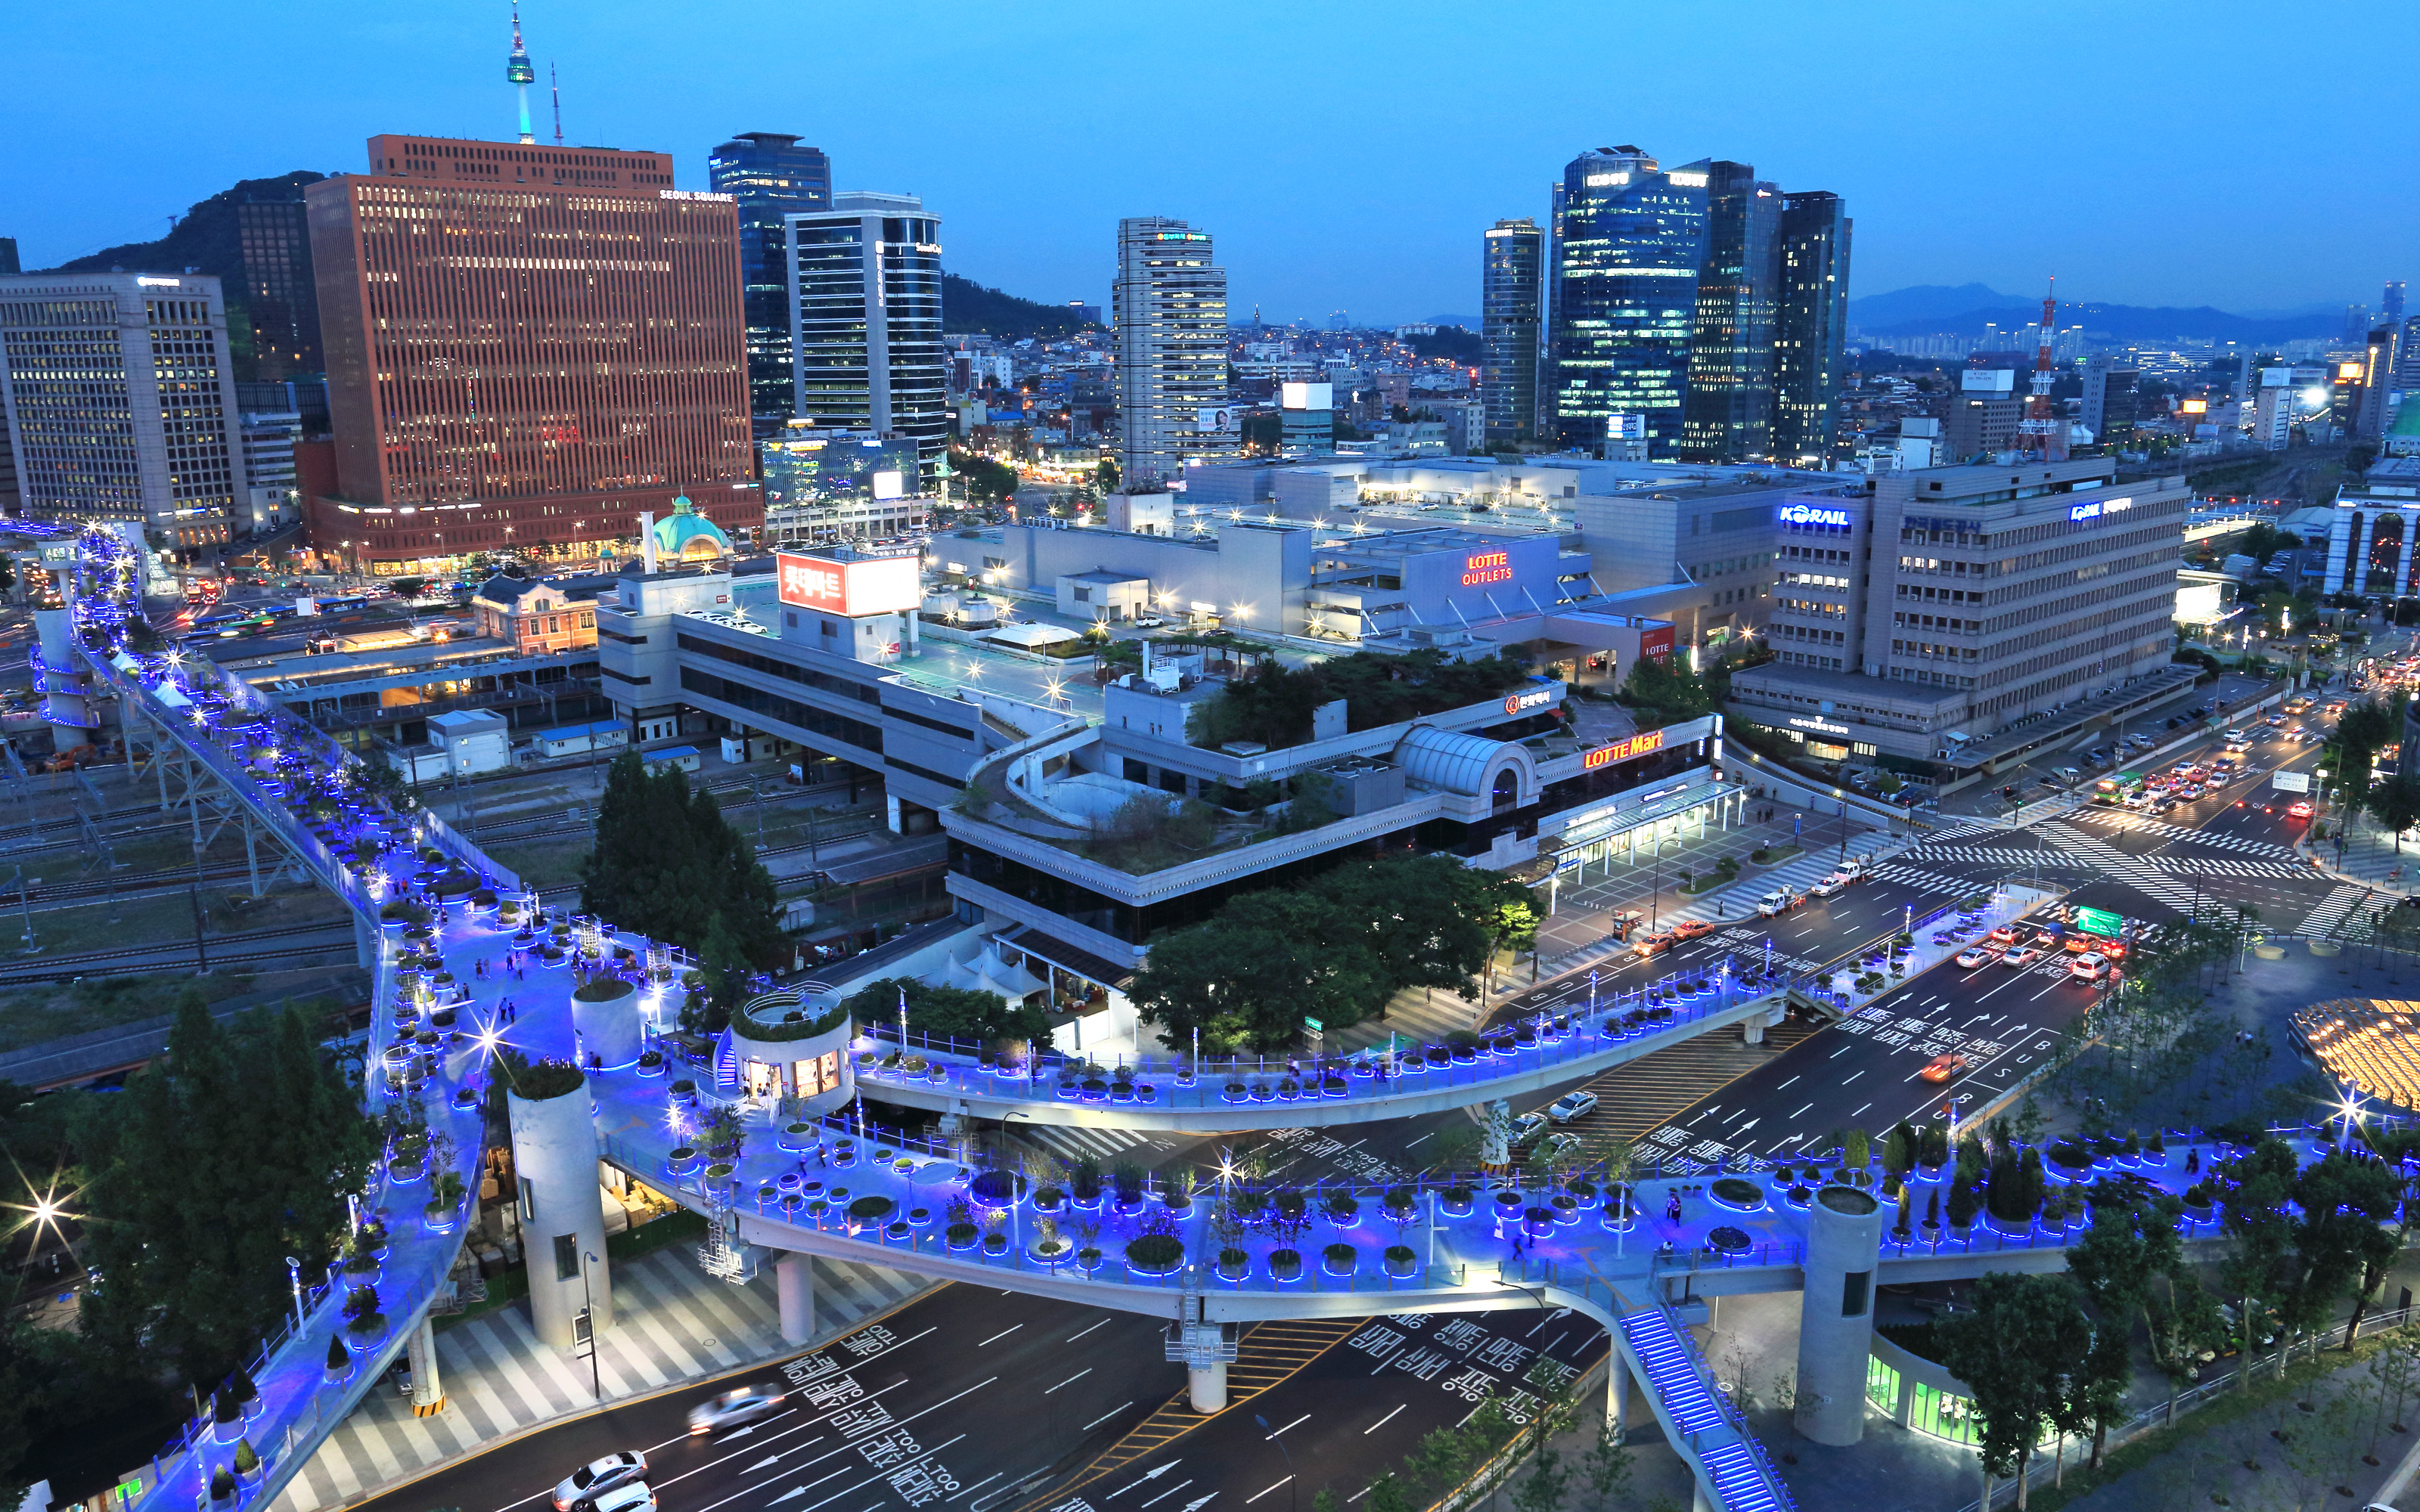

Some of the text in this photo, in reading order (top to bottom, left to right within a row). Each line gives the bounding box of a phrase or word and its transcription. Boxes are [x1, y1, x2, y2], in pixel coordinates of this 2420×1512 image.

[659, 189, 734, 203] SEOUL SQUARE
[915, 241, 932, 253] Seoul
[1779, 504, 1848, 525] KORAIL
[2071, 503, 2100, 522] KORAIL
[1468, 552, 1507, 570] LOTTE
[785, 565, 841, 600] 롯데마트
[1462, 567, 1512, 586] OUTLETS
[1584, 730, 1664, 770] LOTTE Mart
[1857, 1006, 1895, 1023] 청파동
[1894, 1017, 1933, 1033] 청파동
[1835, 1018, 1875, 1035] 삼거리
[1872, 1029, 1913, 1046] 삼거리
[1928, 1027, 1969, 1045] 만리동
[1909, 1039, 1950, 1058] 공덕동
[1965, 1038, 2007, 1055] 만리동
[1300, 1136, 1346, 1158] 서소문
[1649, 1125, 1695, 1147] 청파동
[1688, 1139, 1734, 1161] 청파동
[1348, 1325, 1406, 1359] 삼거리
[1433, 1318, 1488, 1351] 청파동
[1395, 1346, 1451, 1381] 삼거리
[1476, 1337, 1534, 1372] 만리동
[780, 1350, 841, 1386] 서울역
[803, 1374, 864, 1411] 숭례문
[1441, 1365, 1500, 1402] 공덕동
[830, 1400, 895, 1439] 서소문
[858, 1428, 922, 1469] 충정로
[886, 1457, 960, 1508] 충정로역
